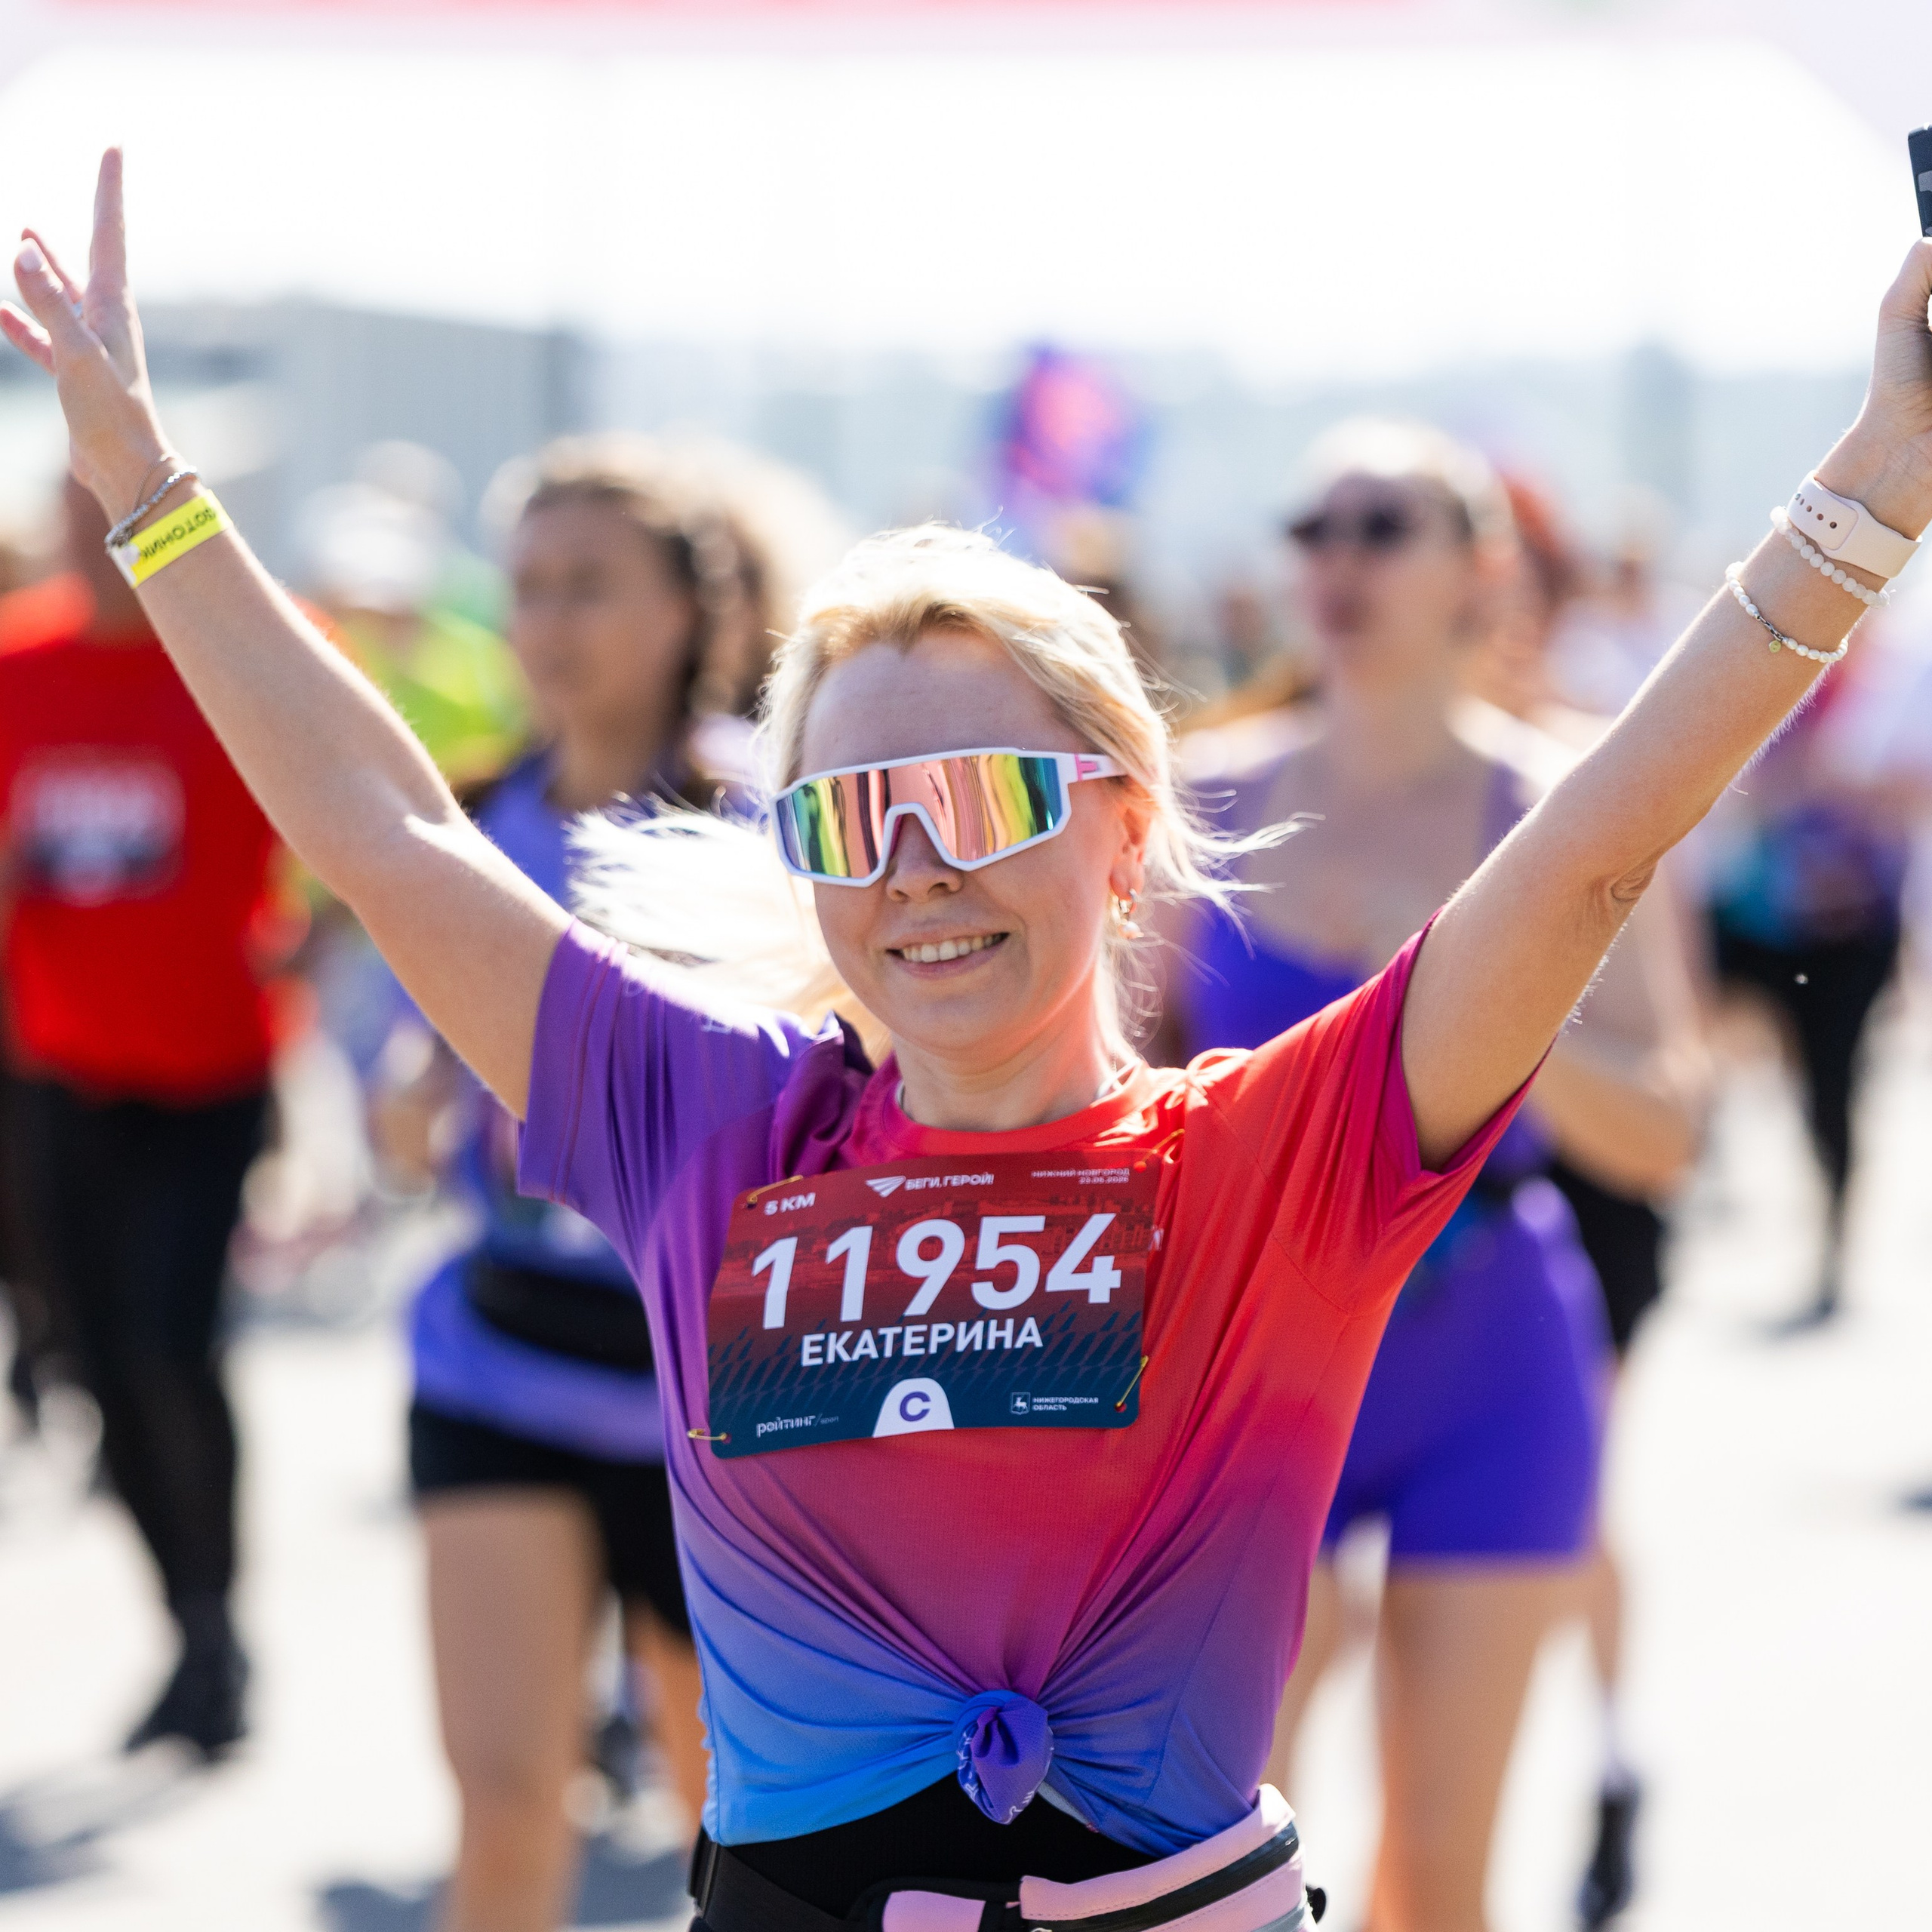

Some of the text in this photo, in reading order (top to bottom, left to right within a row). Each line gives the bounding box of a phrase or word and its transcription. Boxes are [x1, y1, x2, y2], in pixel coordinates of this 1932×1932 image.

[943, 1172, 995, 1187] ГЕРОЙ!
[1077, 1168, 1130, 1177] НОВГОРОД
[764, 1199, 779, 1216] 5
[752, 1213, 1122, 1330] 11954
[801, 1316, 1043, 1367] ЕКАТЕРИНА
[1032, 1396, 1099, 1404] НИЖЕГОРОДСКАЯ
